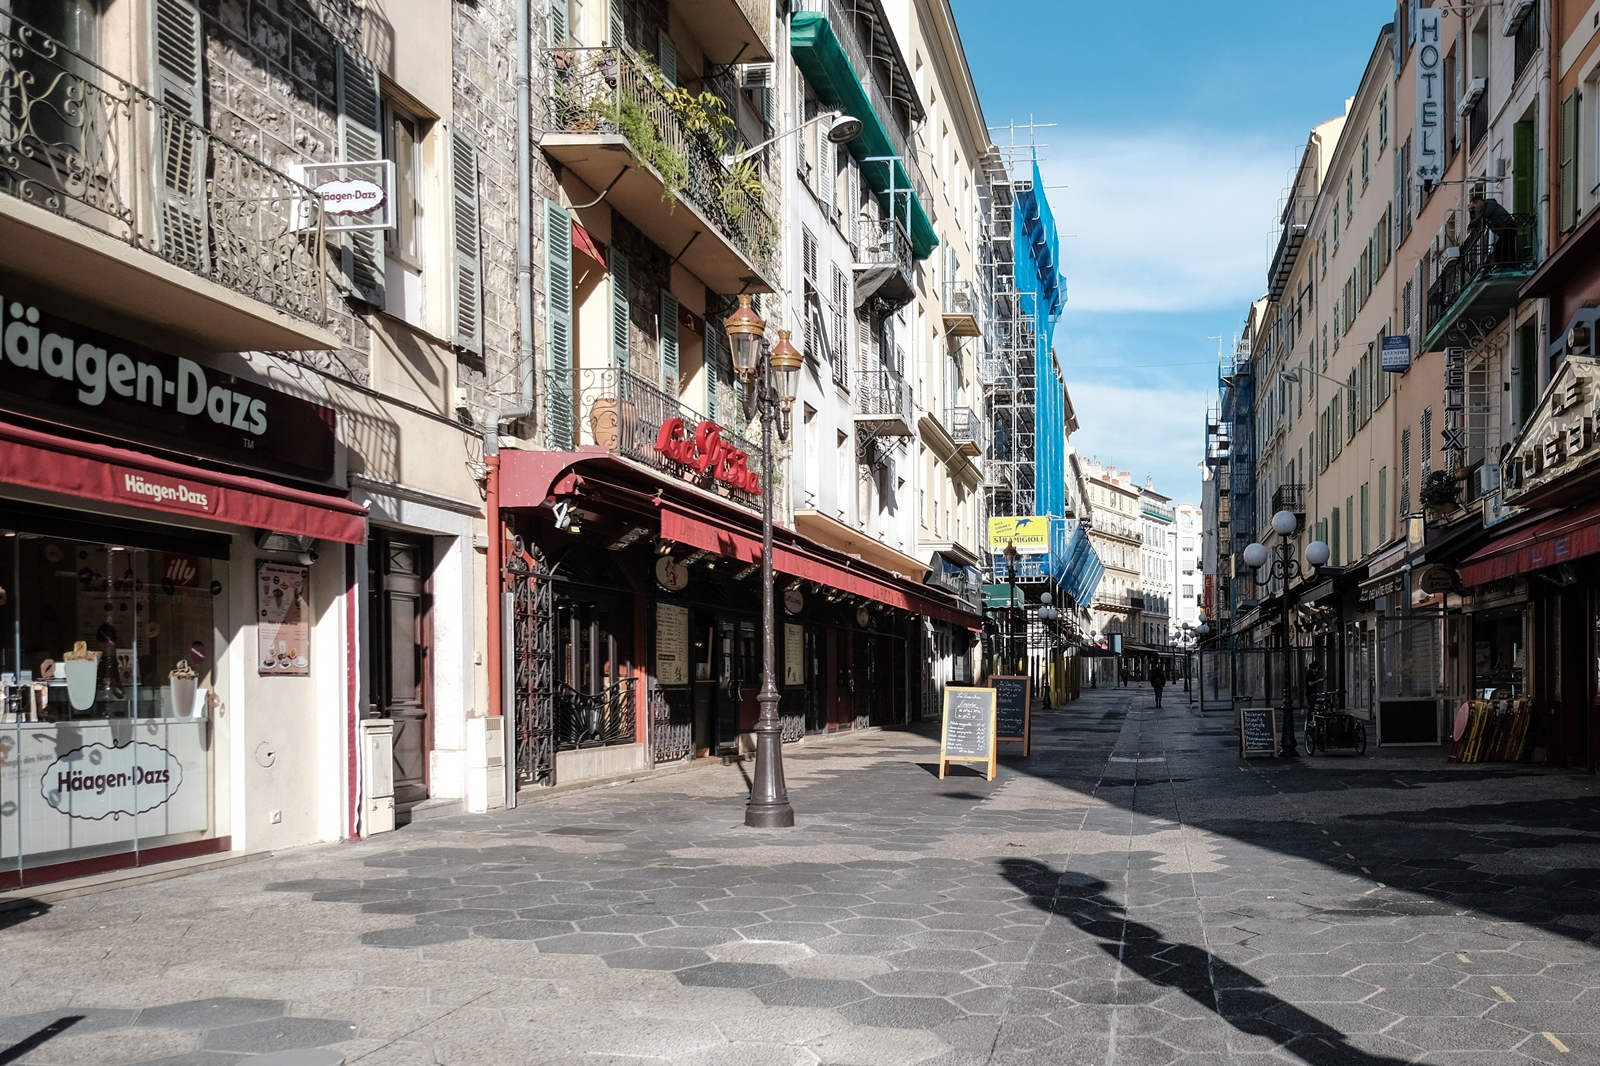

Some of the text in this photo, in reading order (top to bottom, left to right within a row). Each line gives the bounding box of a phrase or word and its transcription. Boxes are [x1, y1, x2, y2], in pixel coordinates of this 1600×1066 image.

[1419, 17, 1439, 156] HOTEL
[0, 295, 268, 436] äagen-Dazs
[1441, 347, 1466, 451] FELIX
[125, 474, 208, 506] Häagen-Dazs
[166, 558, 197, 586] illy
[57, 764, 170, 795] Häagen-Dazs
